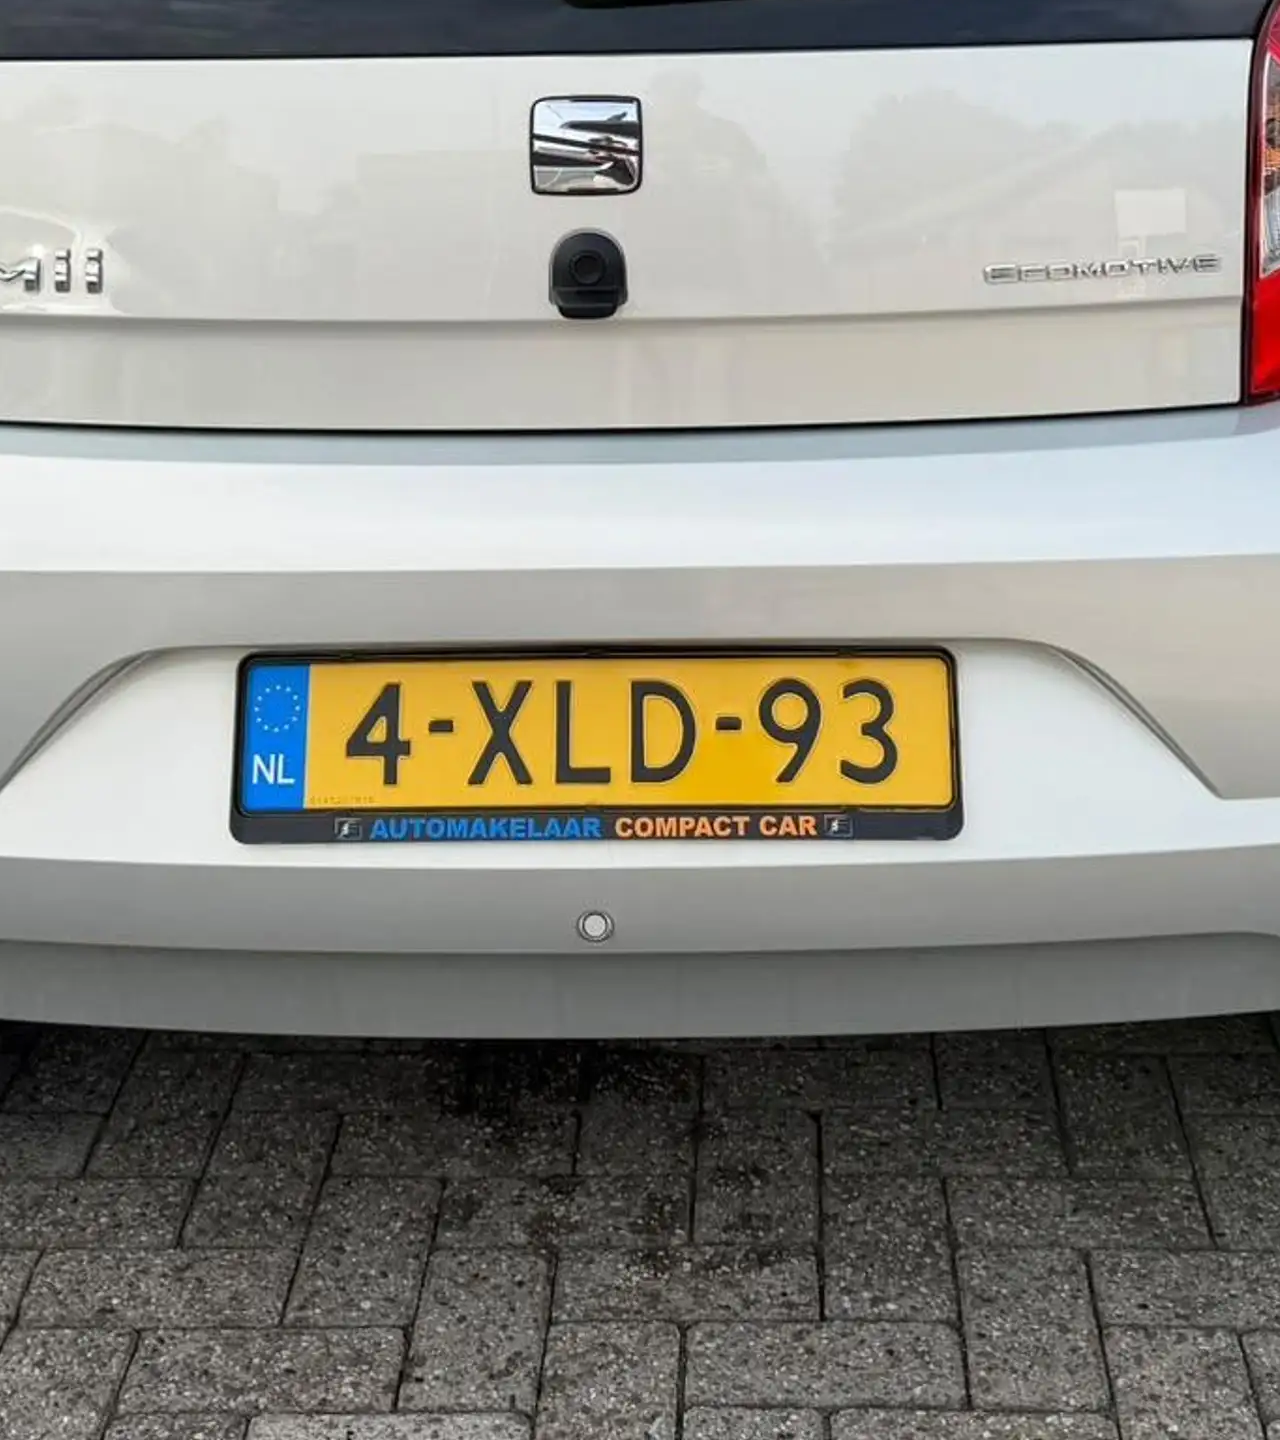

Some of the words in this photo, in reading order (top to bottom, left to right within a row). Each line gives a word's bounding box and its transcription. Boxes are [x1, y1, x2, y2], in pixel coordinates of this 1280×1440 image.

[345, 676, 899, 786] 4-XLD-93
[252, 751, 295, 786] NL
[369, 816, 601, 841] AUTOMAKELAAR
[614, 816, 751, 840] COMPACT
[759, 815, 818, 838] CAR
